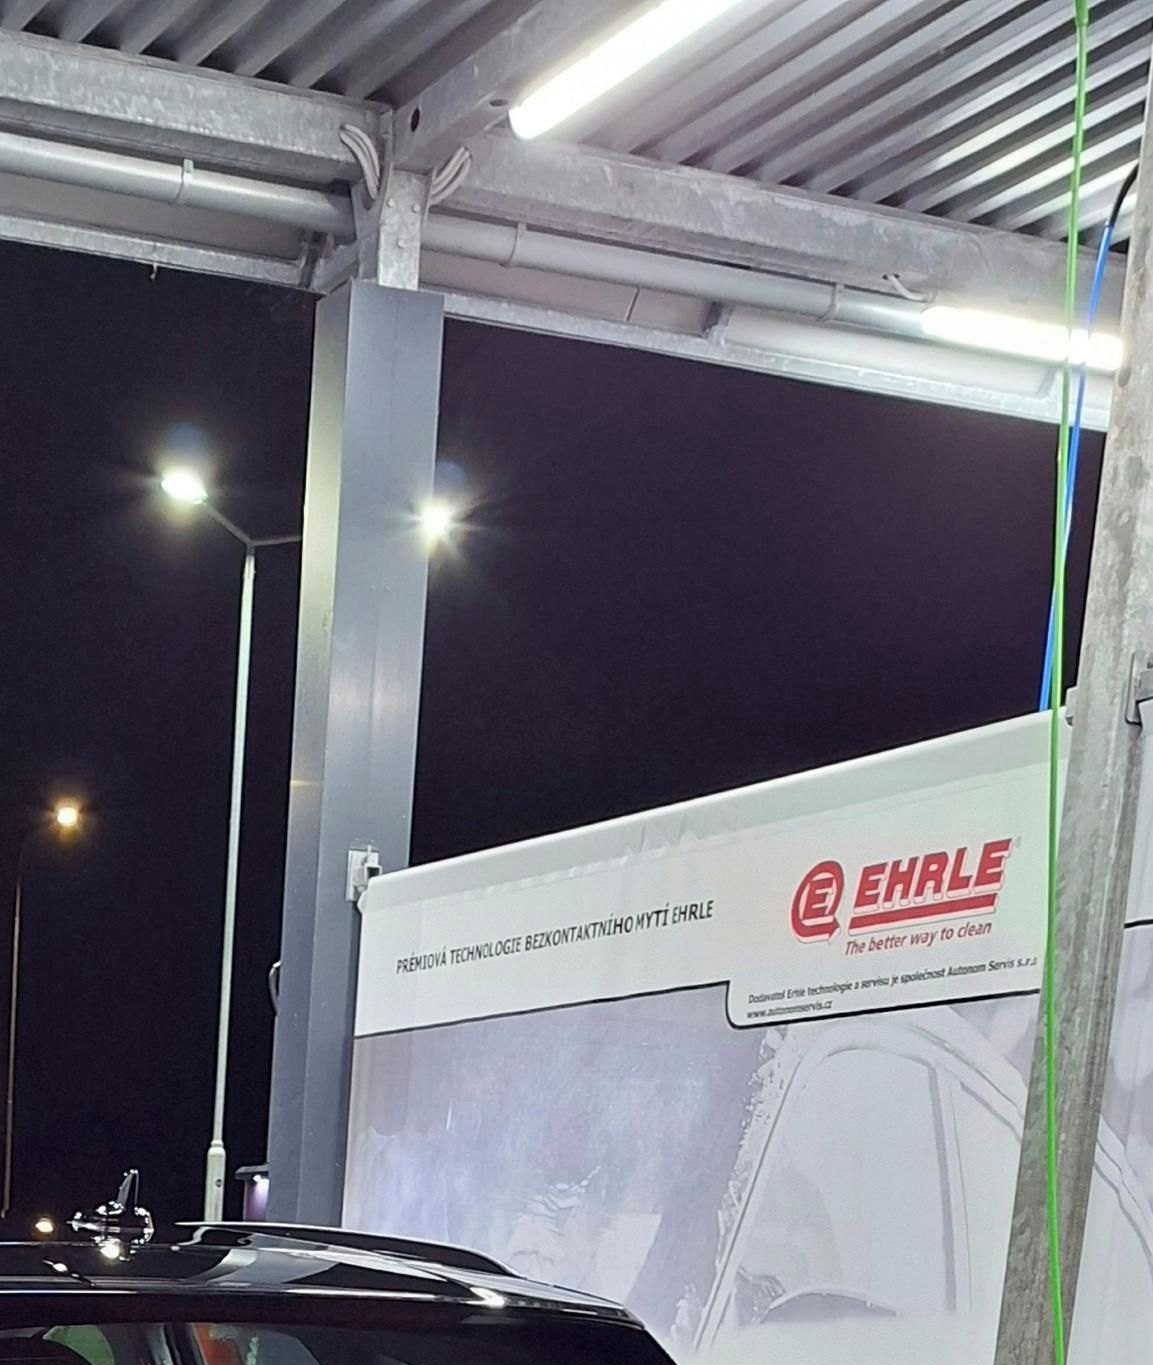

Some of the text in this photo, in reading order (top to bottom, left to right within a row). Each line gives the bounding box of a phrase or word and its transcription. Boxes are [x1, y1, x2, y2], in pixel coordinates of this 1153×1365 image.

[853, 838, 1013, 914] EHRLE
[397, 900, 715, 974] PRÉMIOVÁ TECHNOLOGIE BEZKONTAKTNÍHO MYTÍ EHRLE
[845, 921, 992, 956] The better way to clean
[988, 958, 1015, 971] Servis
